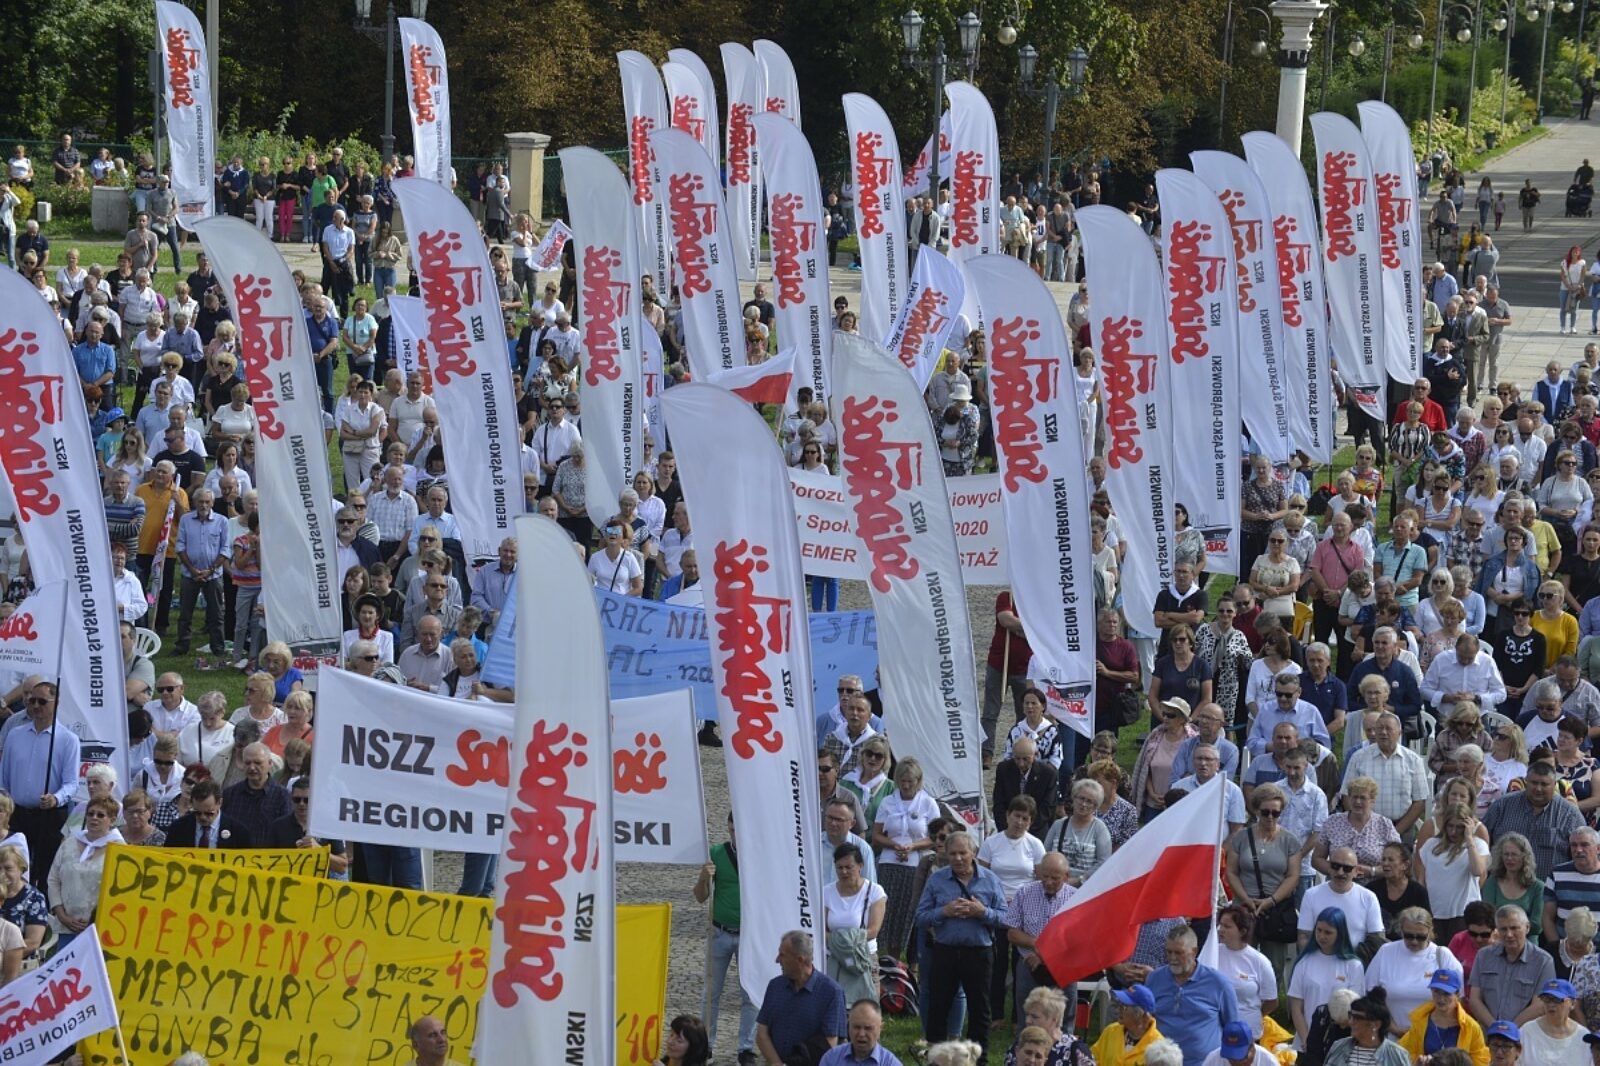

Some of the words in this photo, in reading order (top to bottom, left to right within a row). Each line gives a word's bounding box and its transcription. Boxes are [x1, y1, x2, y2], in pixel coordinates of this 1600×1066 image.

[806, 514, 851, 533] Społ
[802, 542, 857, 563] EMER
[341, 724, 435, 775] NSZZ
[339, 797, 473, 834] REGION
[109, 854, 301, 924] DEPTANE
